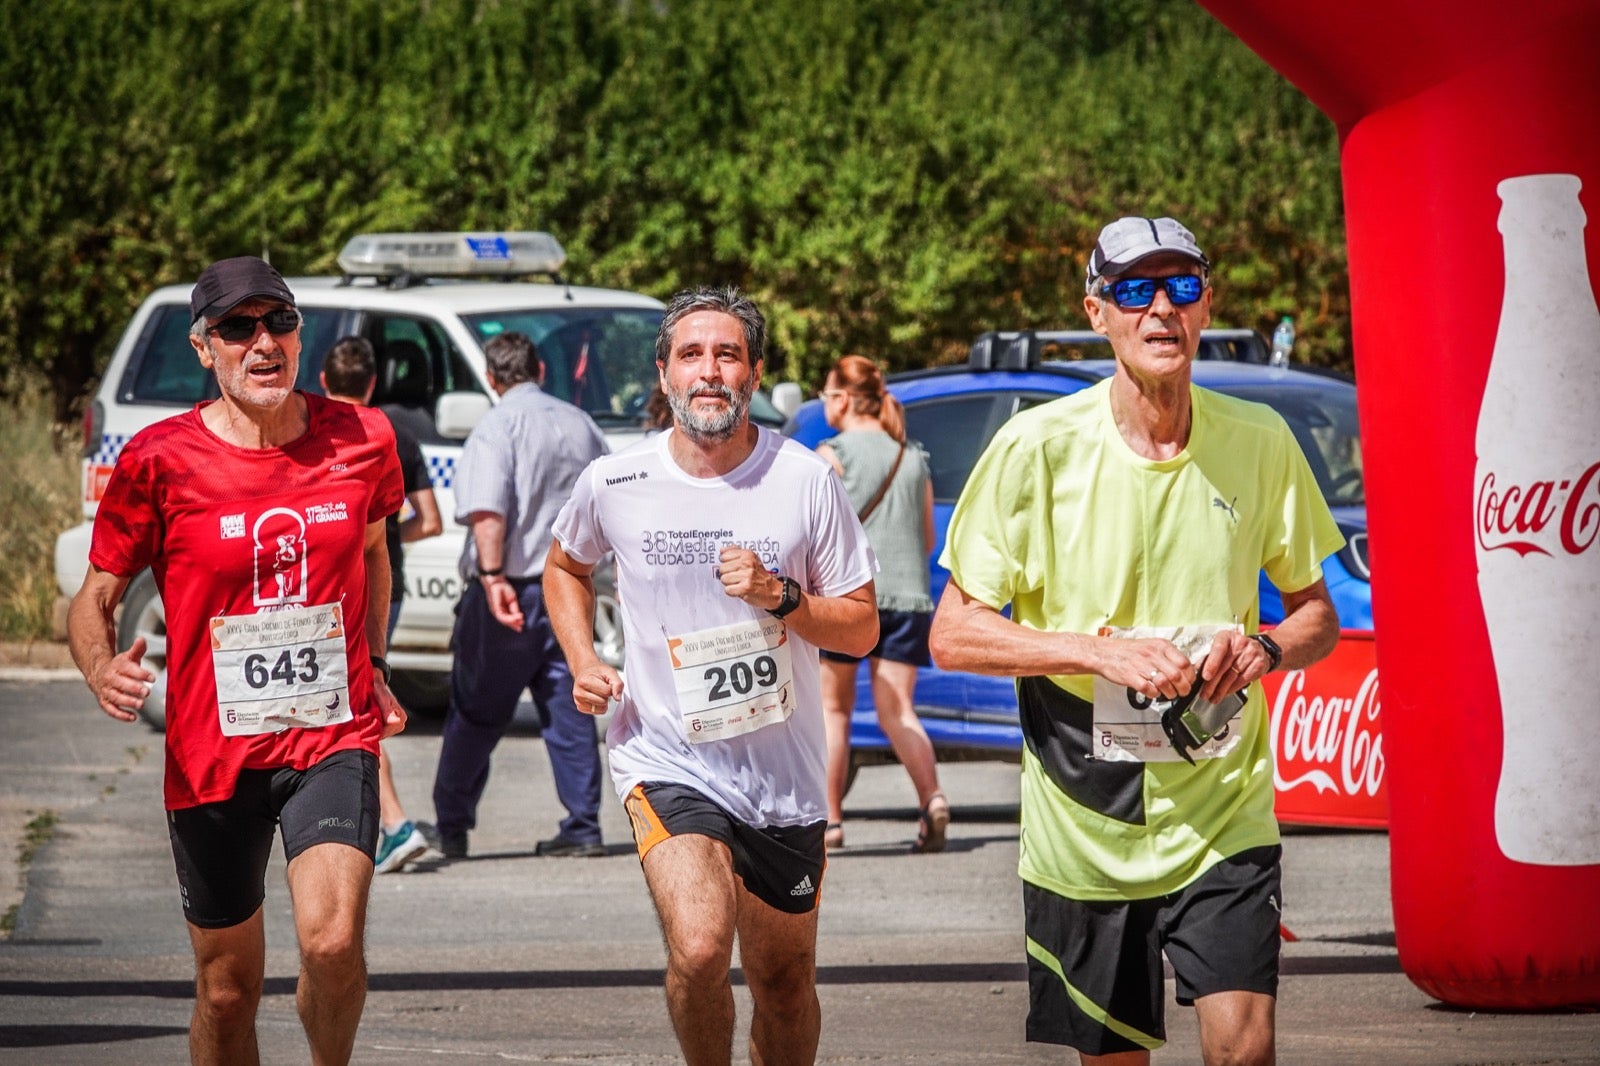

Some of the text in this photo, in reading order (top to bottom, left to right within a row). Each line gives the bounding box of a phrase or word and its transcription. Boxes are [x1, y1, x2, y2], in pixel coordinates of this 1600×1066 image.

[605, 472, 637, 486] luanvi
[1477, 461, 1600, 558] Coca-C
[316, 511, 348, 524] GRANADA
[641, 529, 734, 552] 38 TotalEnergies
[669, 539, 716, 553] Media
[645, 552, 694, 565] CIUDAD
[699, 552, 715, 565] DE
[416, 576, 458, 599] LOC
[763, 625, 778, 636] 2022
[244, 647, 319, 688] 643
[704, 655, 777, 701] 209
[1269, 668, 1386, 798] Coca-Co
[318, 817, 356, 830] FILA
[790, 886, 815, 896] adidas
